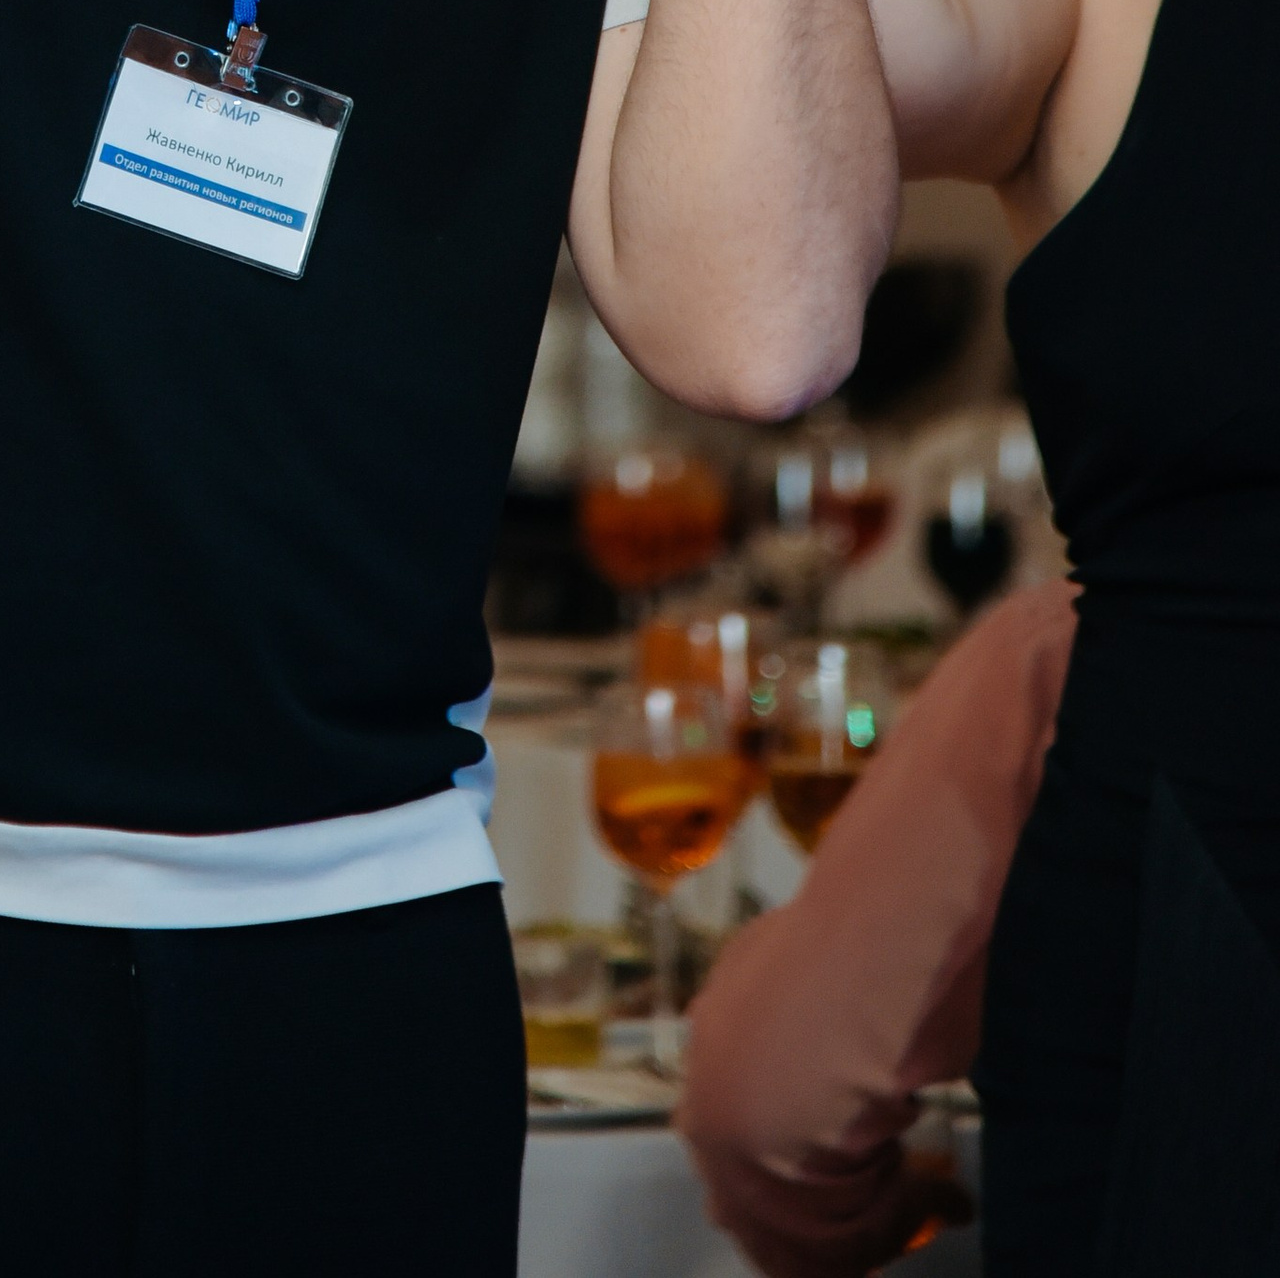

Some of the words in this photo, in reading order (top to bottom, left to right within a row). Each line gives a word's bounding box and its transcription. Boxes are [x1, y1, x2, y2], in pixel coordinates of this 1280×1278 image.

[114, 154, 148, 174] Отдел
[149, 168, 200, 193] развития
[202, 186, 237, 206] новых
[239, 199, 294, 224] регионов
[146, 128, 222, 166] Жавненко
[226, 156, 283, 187] Кирилл
